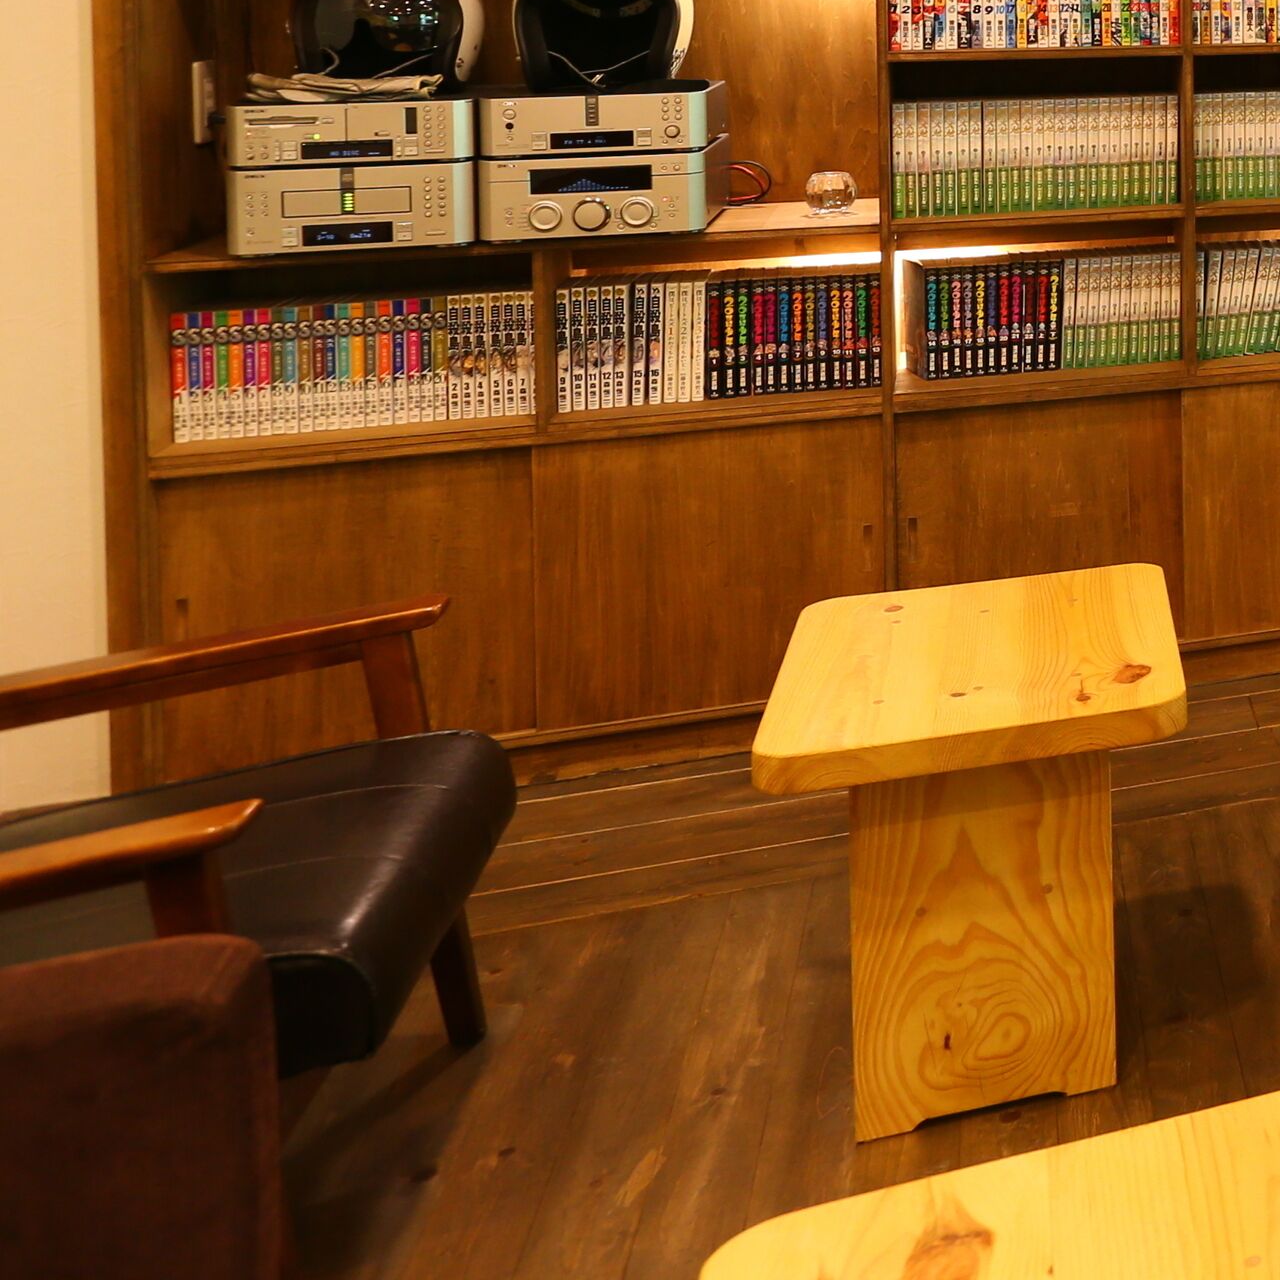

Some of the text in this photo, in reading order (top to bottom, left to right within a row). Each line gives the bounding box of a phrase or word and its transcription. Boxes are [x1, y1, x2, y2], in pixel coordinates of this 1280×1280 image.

[973, 5, 981, 13] 8
[985, 6, 993, 14] 9
[615, 371, 624, 379] 13
[633, 370, 642, 378] 15
[650, 369, 659, 377] 16
[493, 380, 499, 388] 5
[507, 379, 513, 387] 6
[520, 379, 525, 387] 7
[560, 377, 566, 385] 9
[451, 383, 457, 391] 2
[464, 383, 470, 391] 3
